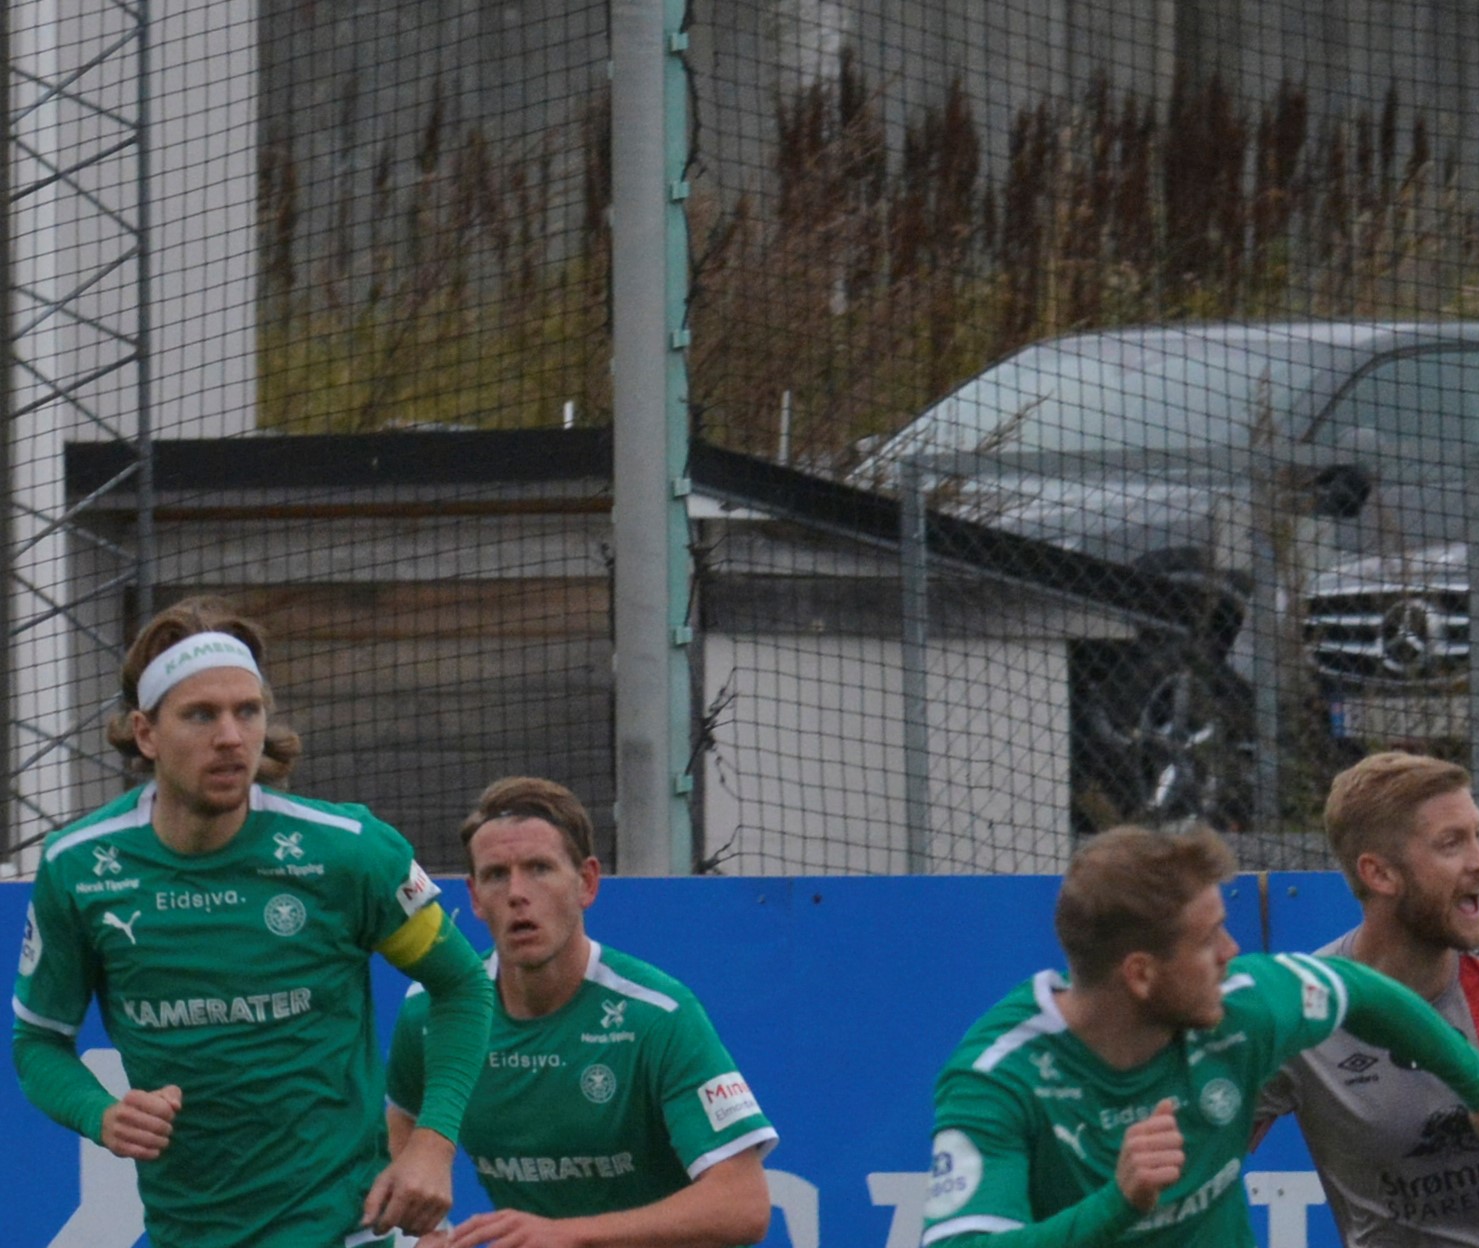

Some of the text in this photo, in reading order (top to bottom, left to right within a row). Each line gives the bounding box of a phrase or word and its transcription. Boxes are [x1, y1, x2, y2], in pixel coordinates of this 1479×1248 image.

[286, 863, 325, 877] Tipping
[104, 877, 140, 892] Tipping
[476, 1151, 635, 1183] AMERATER
